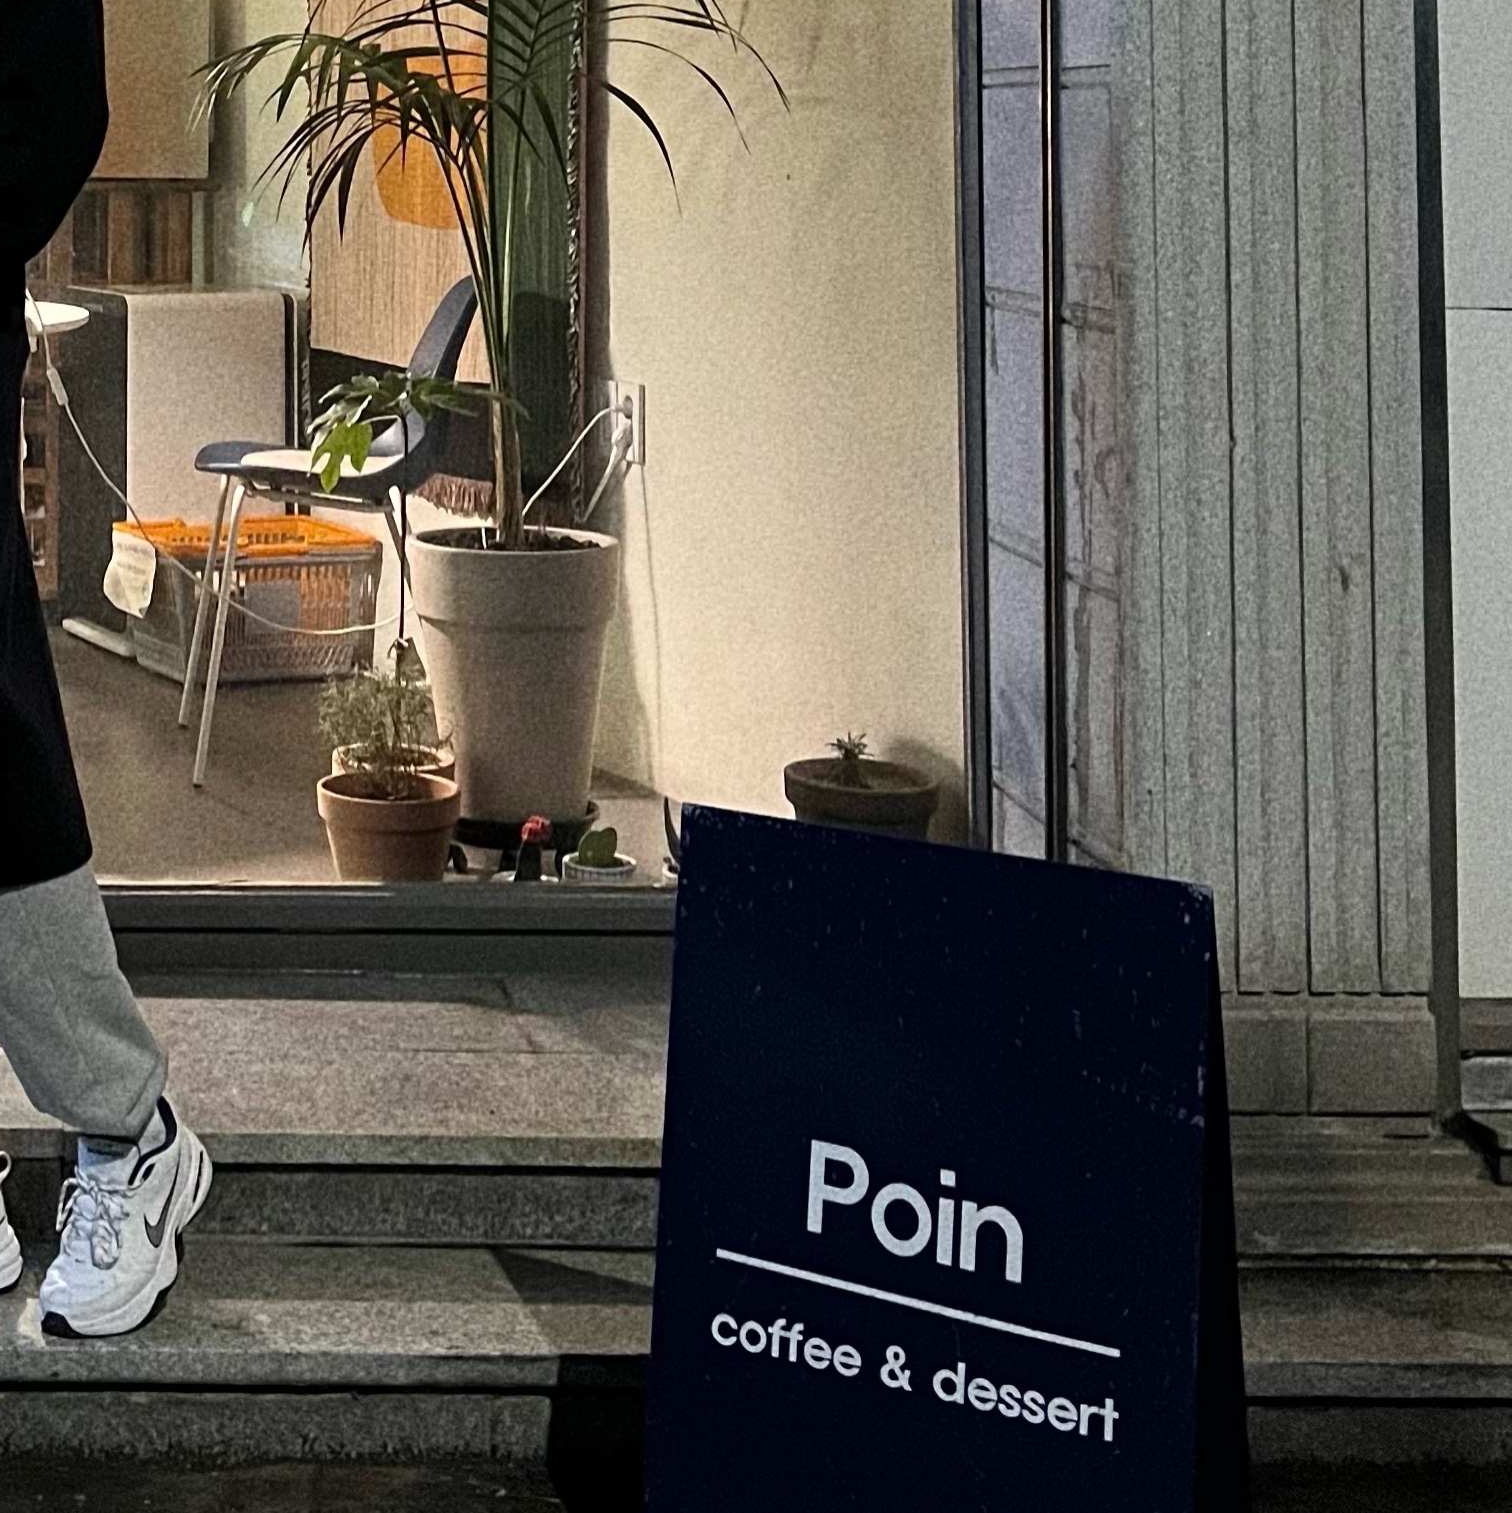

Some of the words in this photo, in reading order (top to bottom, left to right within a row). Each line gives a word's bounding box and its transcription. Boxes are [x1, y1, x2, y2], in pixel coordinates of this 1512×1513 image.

[806, 1138, 1024, 1284] Poin
[710, 1312, 862, 1377] coffee
[879, 1344, 913, 1392] &
[931, 1361, 1120, 1442] dessert
